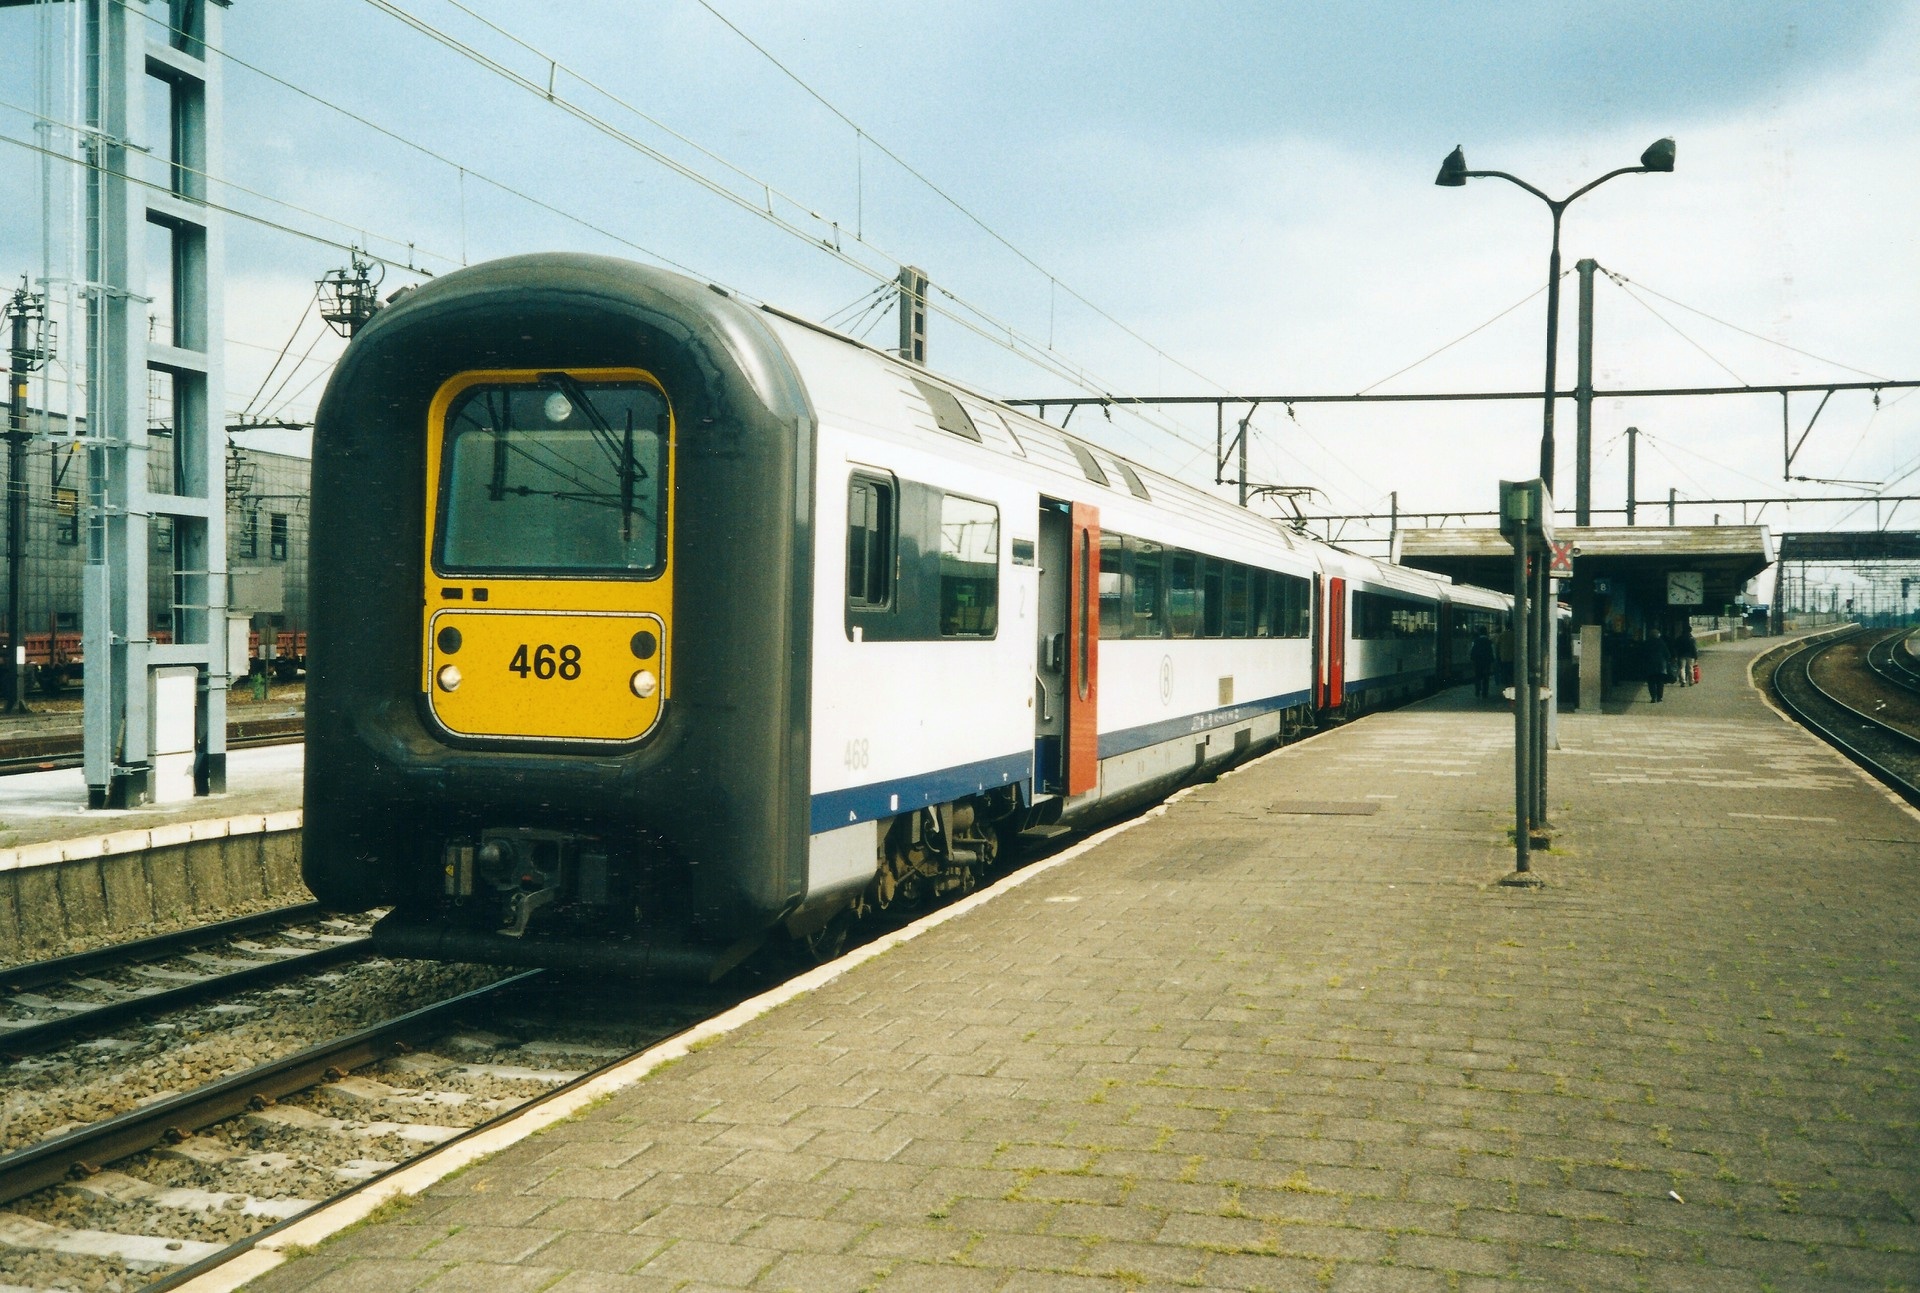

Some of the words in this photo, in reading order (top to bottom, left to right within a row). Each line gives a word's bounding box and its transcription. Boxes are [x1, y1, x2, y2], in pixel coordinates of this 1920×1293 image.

[1600, 583, 1607, 591] 8
[509, 644, 581, 680] 468
[844, 738, 869, 771] 468
